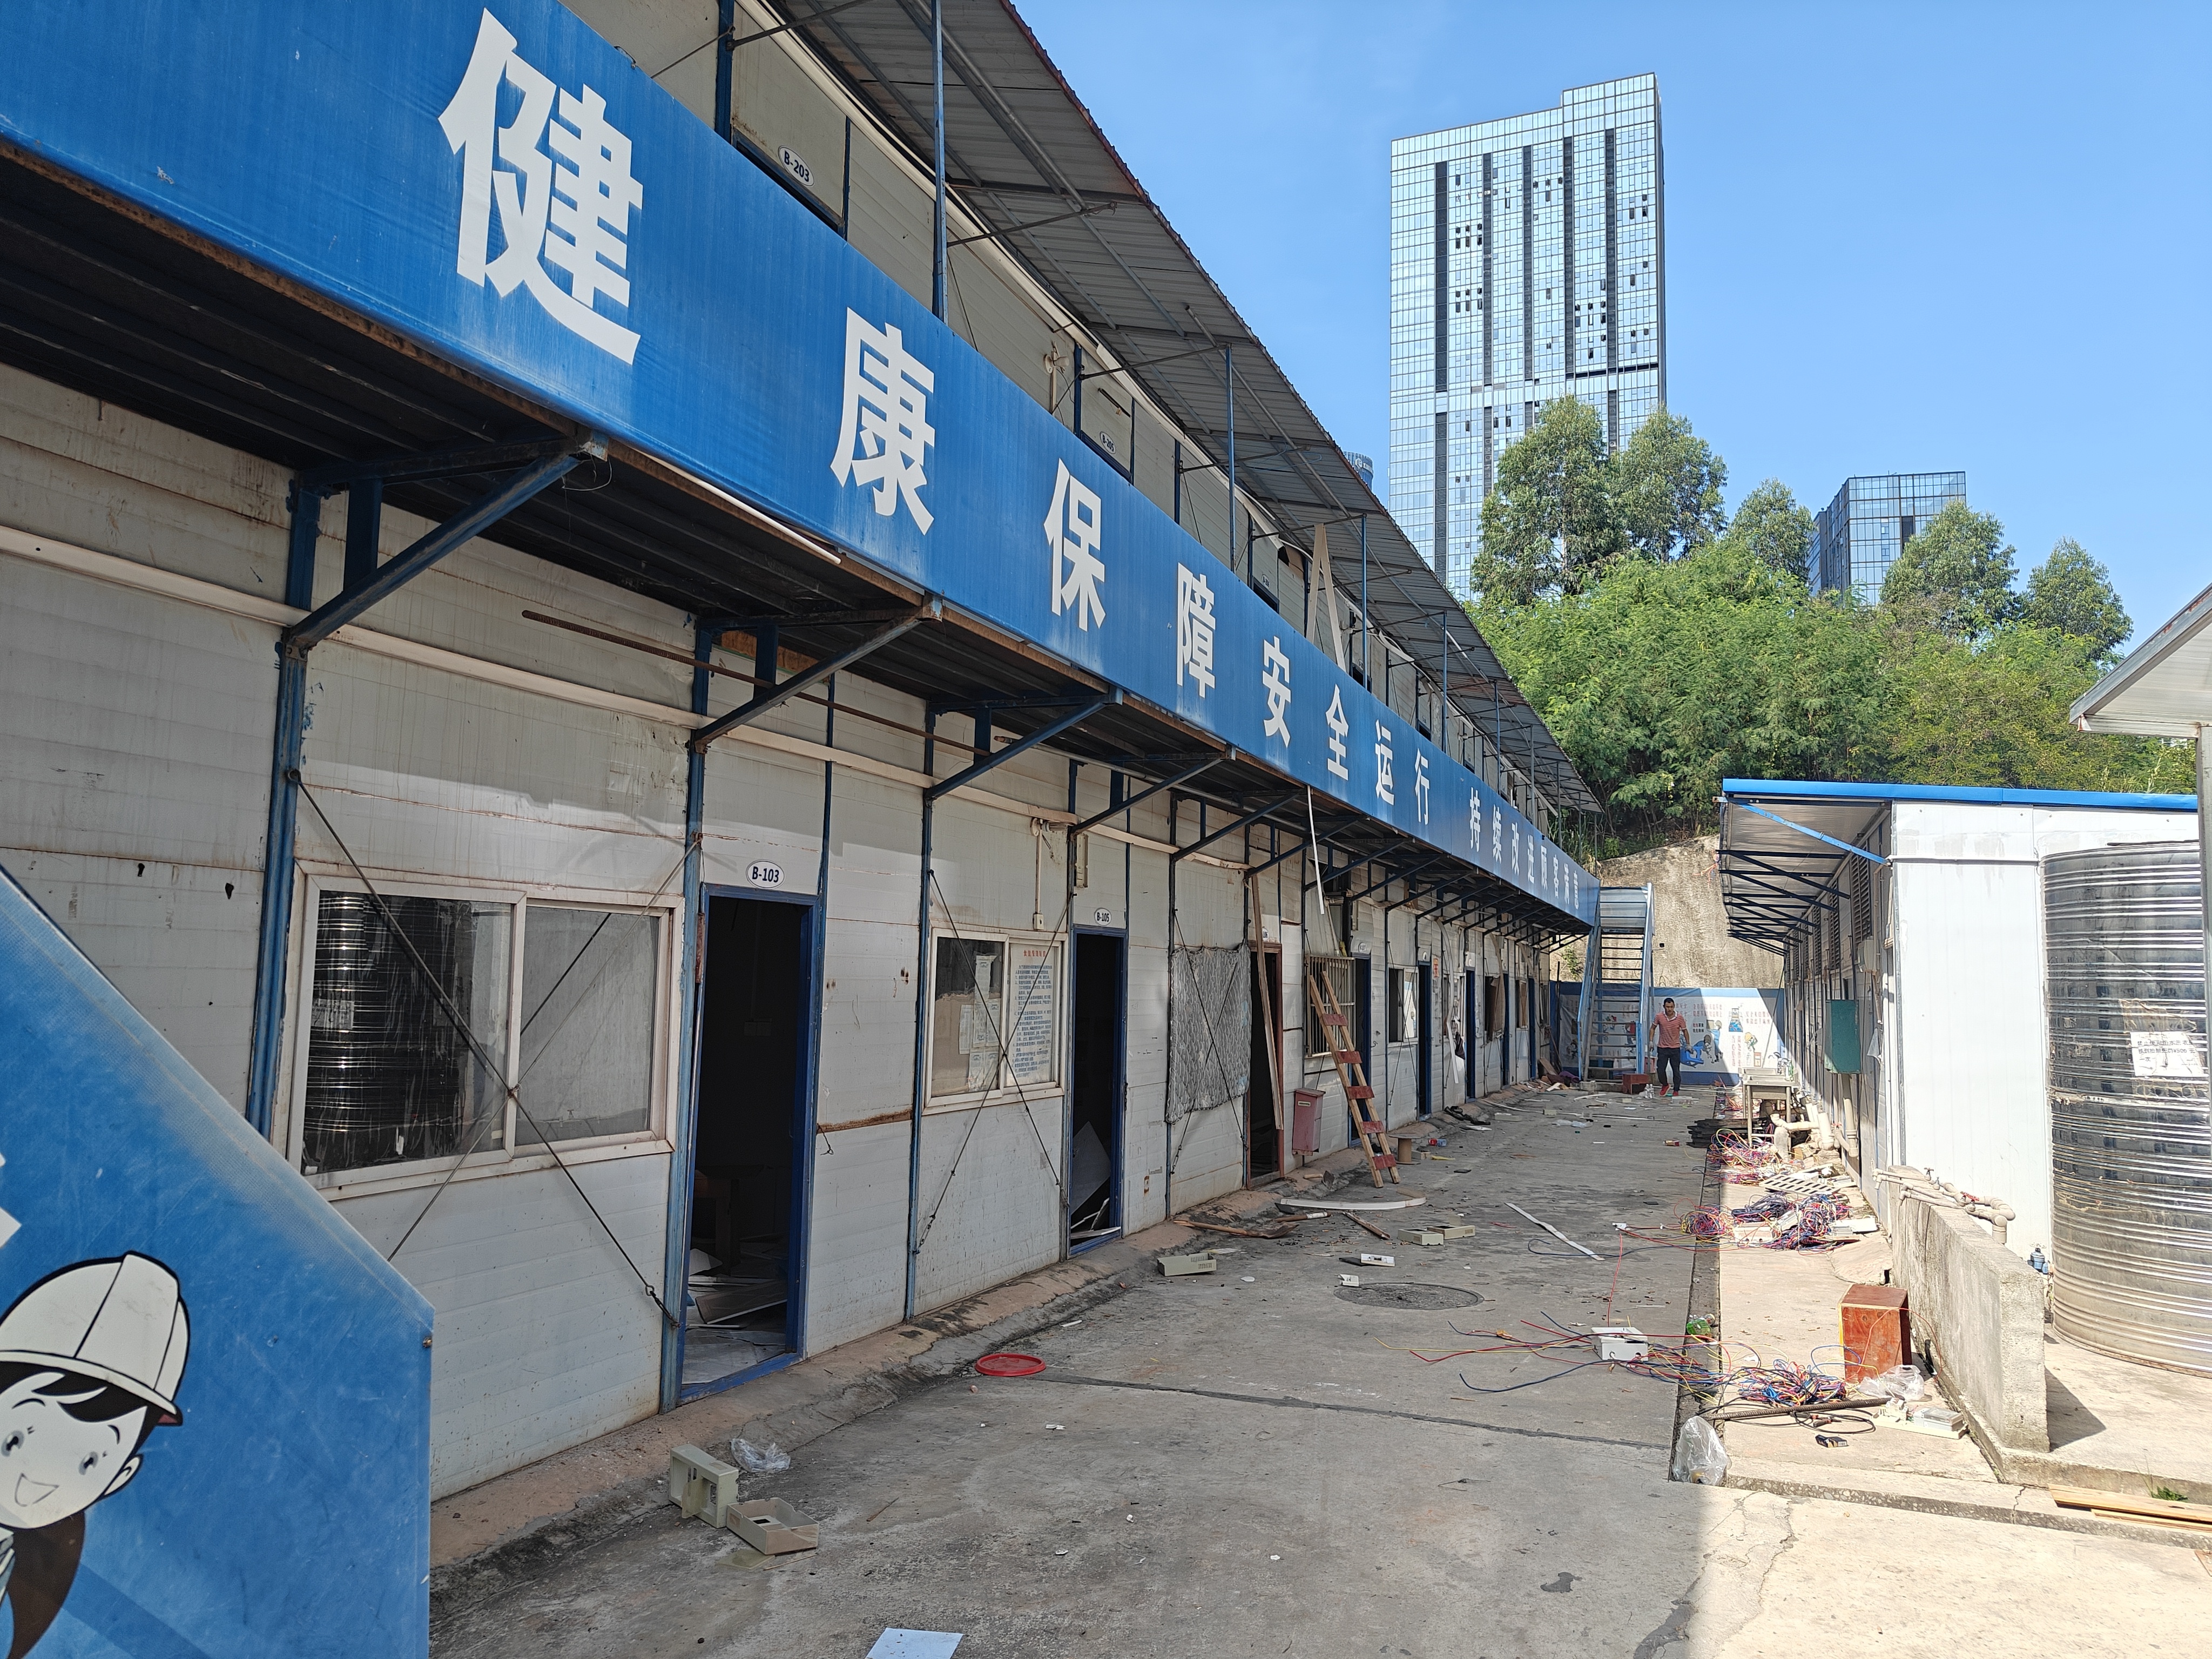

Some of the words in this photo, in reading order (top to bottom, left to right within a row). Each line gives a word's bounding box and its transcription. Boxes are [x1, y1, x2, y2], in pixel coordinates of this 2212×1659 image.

[784, 150, 810, 182] B-203
[437, 7, 1430, 826] 健康保障安全运行
[1102, 434, 1115, 452] B-205
[752, 866, 779, 883] B-103
[1097, 912, 1110, 922] B-105
